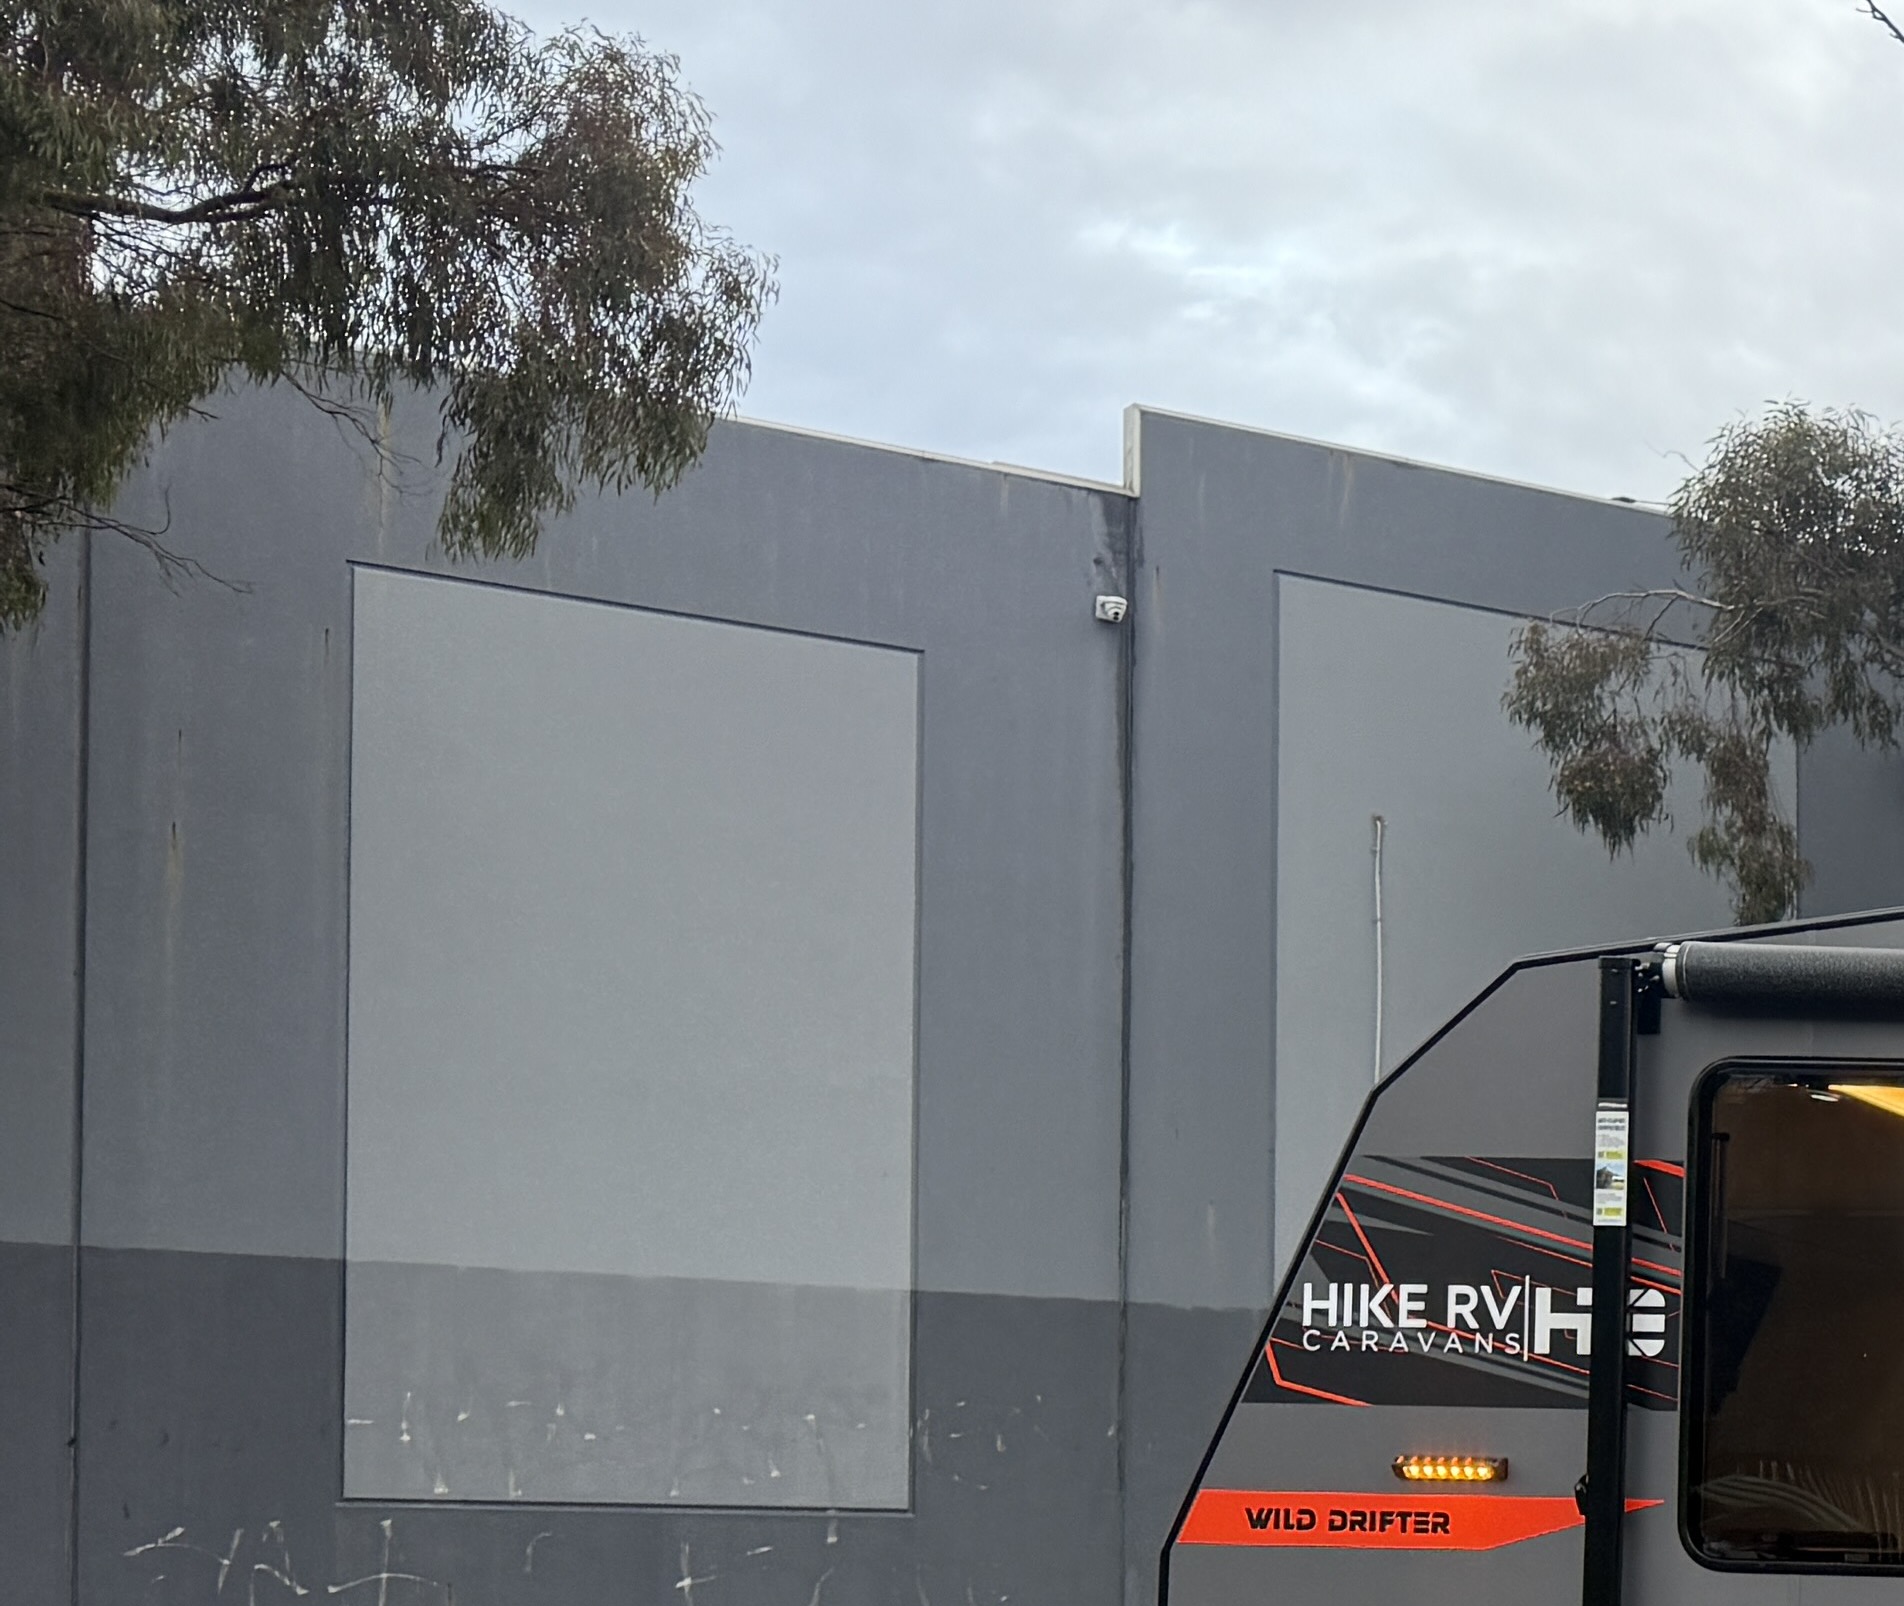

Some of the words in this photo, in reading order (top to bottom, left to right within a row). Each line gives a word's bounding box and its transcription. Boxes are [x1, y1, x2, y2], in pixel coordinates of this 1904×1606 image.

[1302, 1282, 1428, 1328] HIKE
[1446, 1284, 1522, 1330] RV
[1302, 1329, 1521, 1354] CARAVANS
[1245, 1507, 1317, 1531] WILD
[1328, 1509, 1450, 1534] DRIFTER
